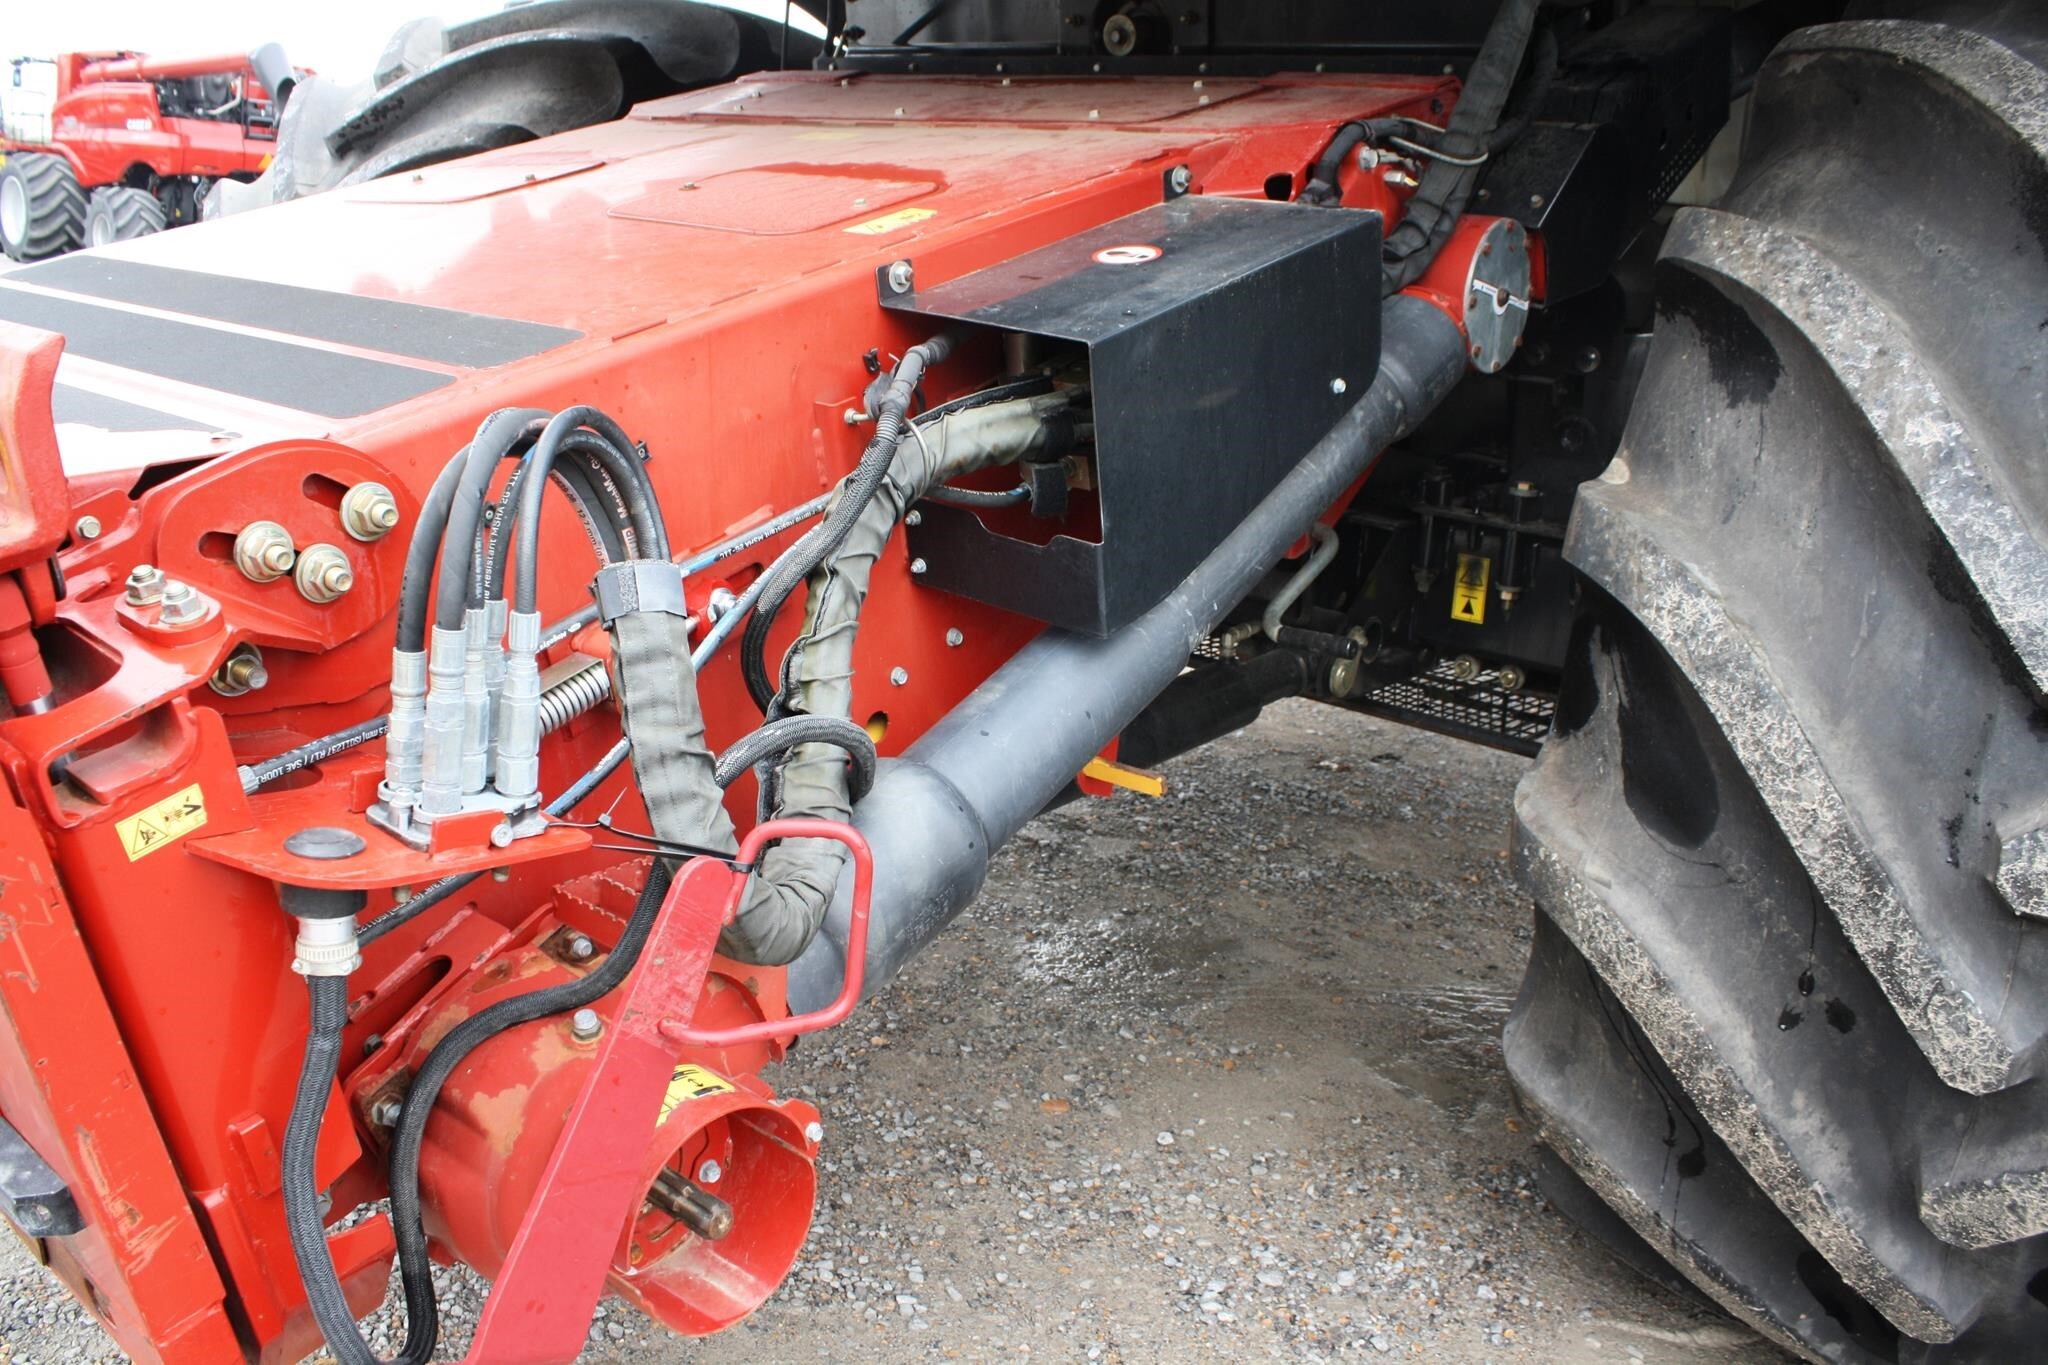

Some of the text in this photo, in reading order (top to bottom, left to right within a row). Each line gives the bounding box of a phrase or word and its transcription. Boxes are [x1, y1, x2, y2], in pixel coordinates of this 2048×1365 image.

[492, 506, 506, 537] MSHA
[310, 749, 326, 764] R17
[284, 759, 303, 773] SAE
